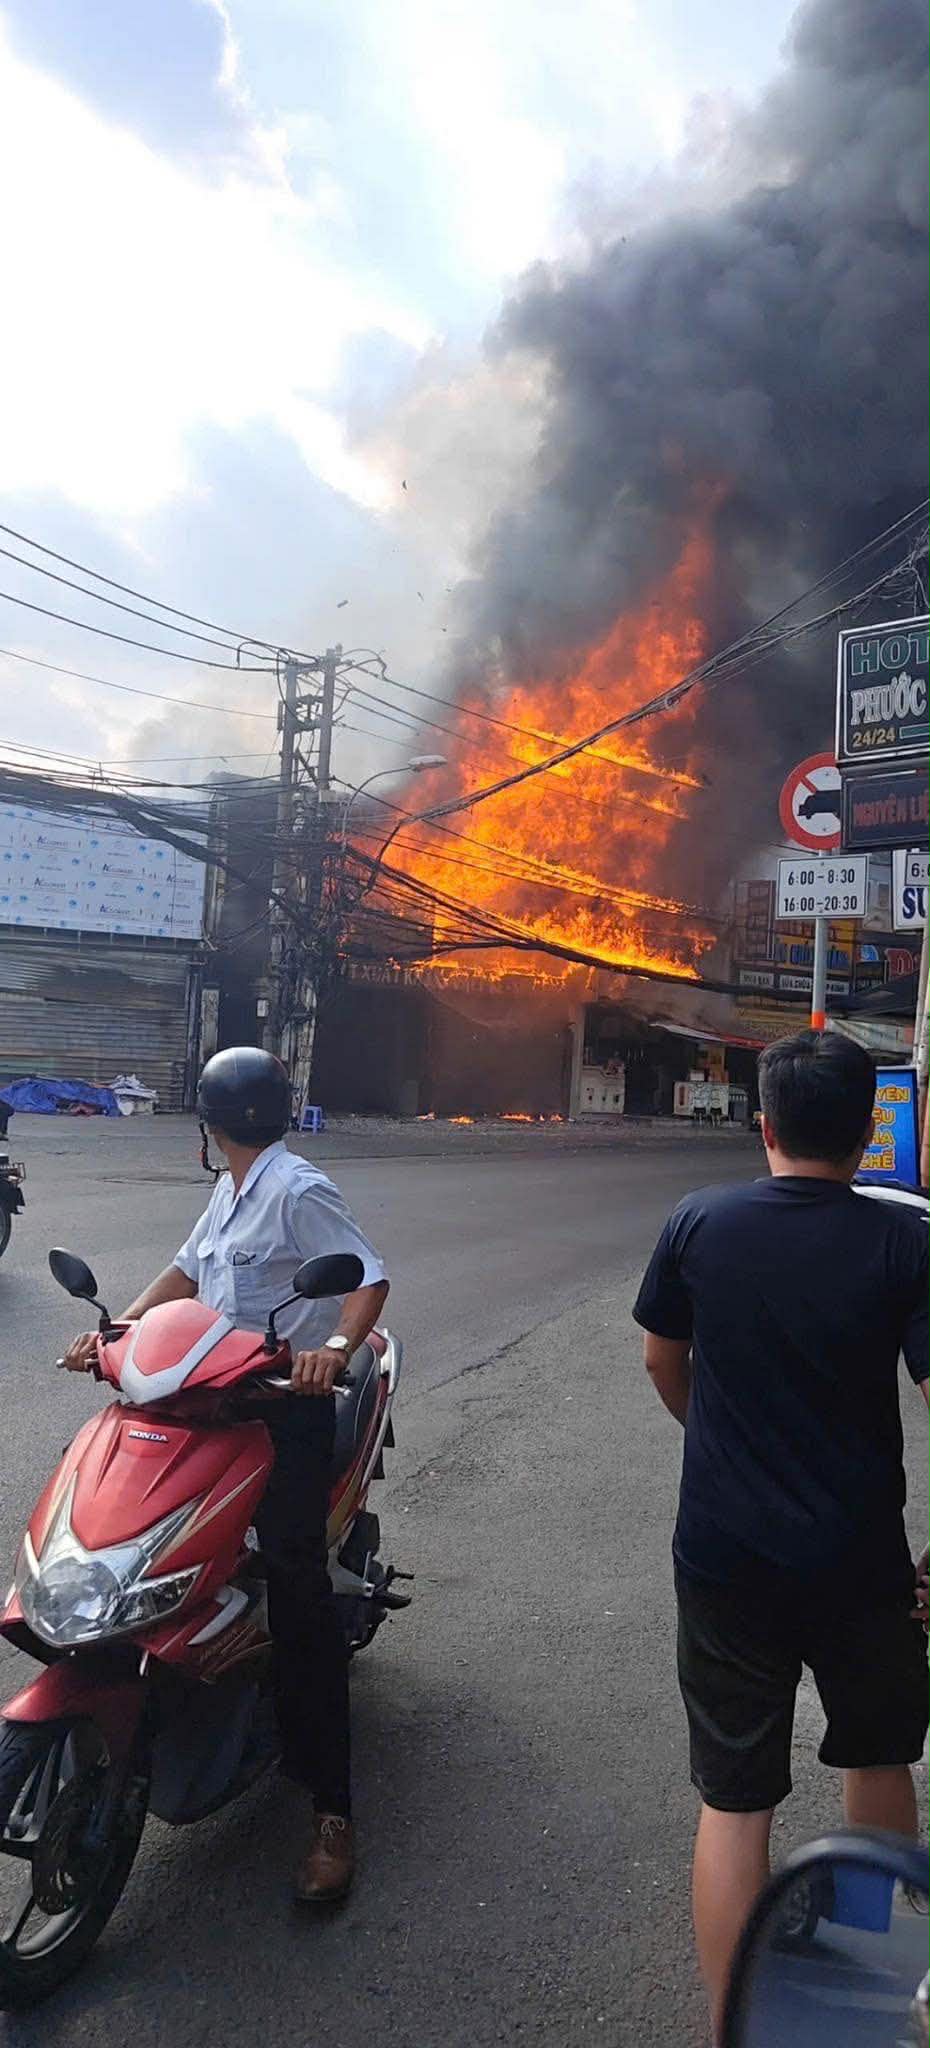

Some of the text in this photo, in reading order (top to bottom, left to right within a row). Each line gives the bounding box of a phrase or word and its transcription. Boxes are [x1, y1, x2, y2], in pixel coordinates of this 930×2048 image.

[852, 727, 896, 748] 24/24
[787, 870, 815, 886] 6:00
[827, 868, 855, 884] 8:30
[128, 1430, 169, 1442] HONDA
